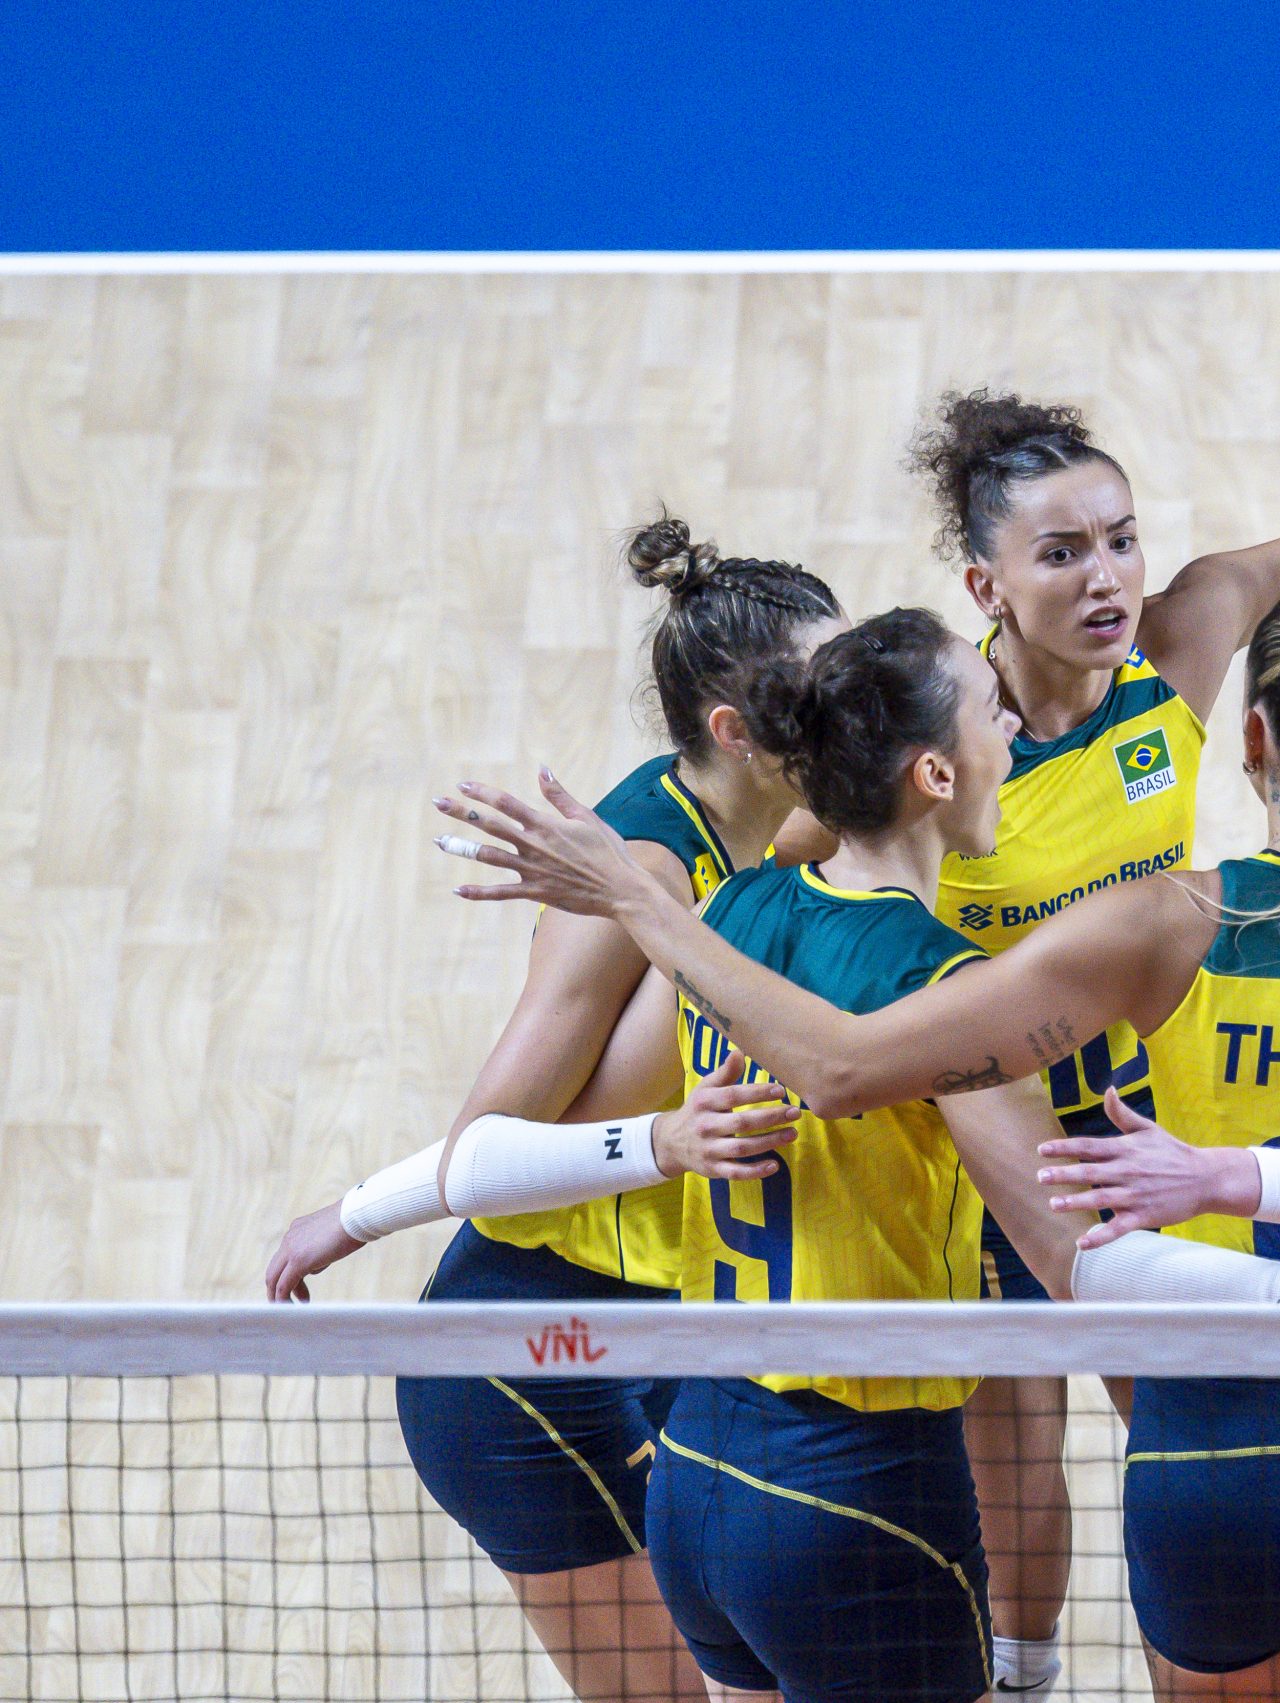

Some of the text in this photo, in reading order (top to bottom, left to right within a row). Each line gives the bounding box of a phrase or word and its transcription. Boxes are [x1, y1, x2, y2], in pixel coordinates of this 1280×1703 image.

[1126, 770, 1175, 801] BRASIL
[1000, 886, 1085, 927] BANCO
[1119, 841, 1185, 882] BRASIL
[526, 1316, 607, 1366] VNL
